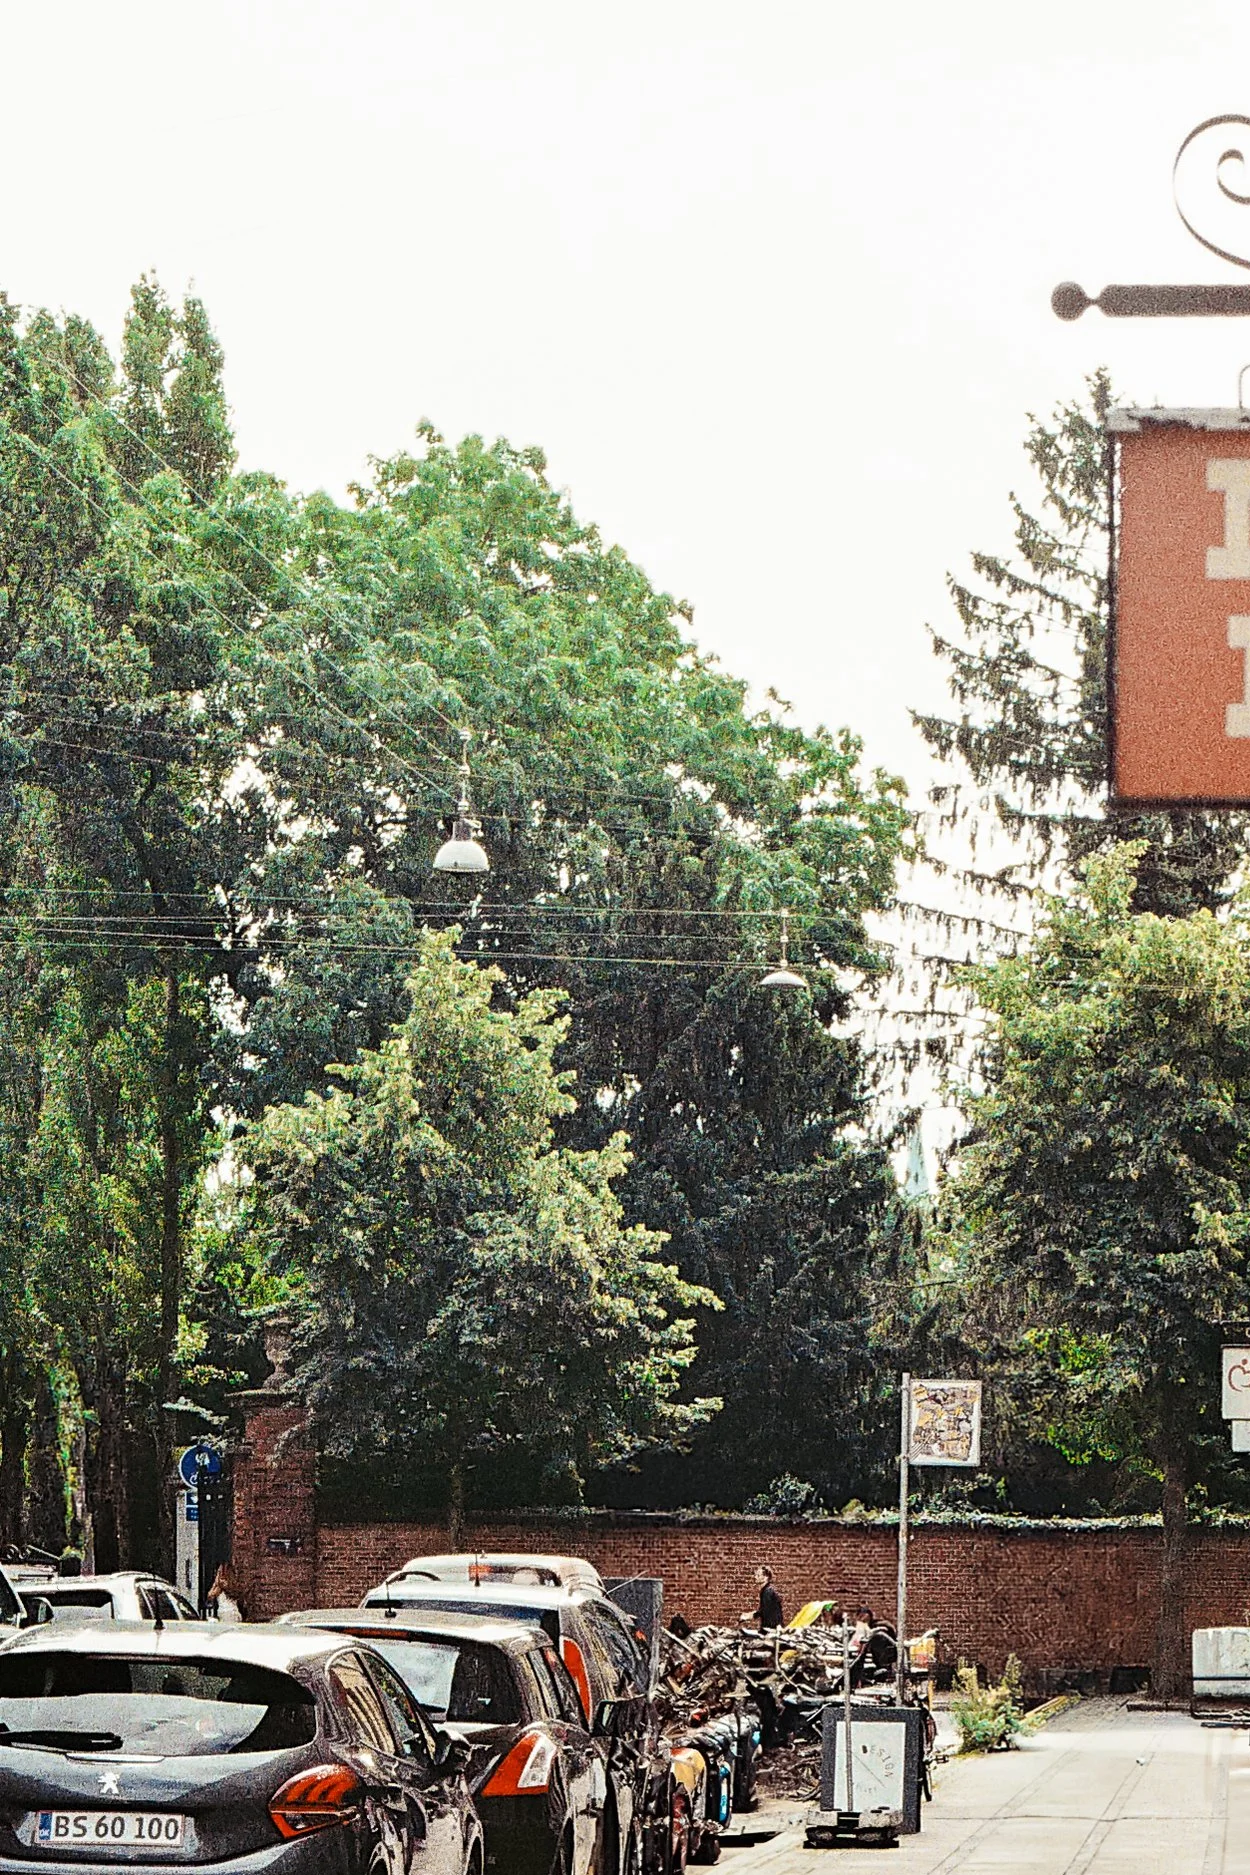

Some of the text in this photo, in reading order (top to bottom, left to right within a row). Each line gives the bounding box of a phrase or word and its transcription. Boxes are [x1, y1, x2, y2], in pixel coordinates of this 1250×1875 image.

[54, 1814, 179, 1841] BS 60 100
